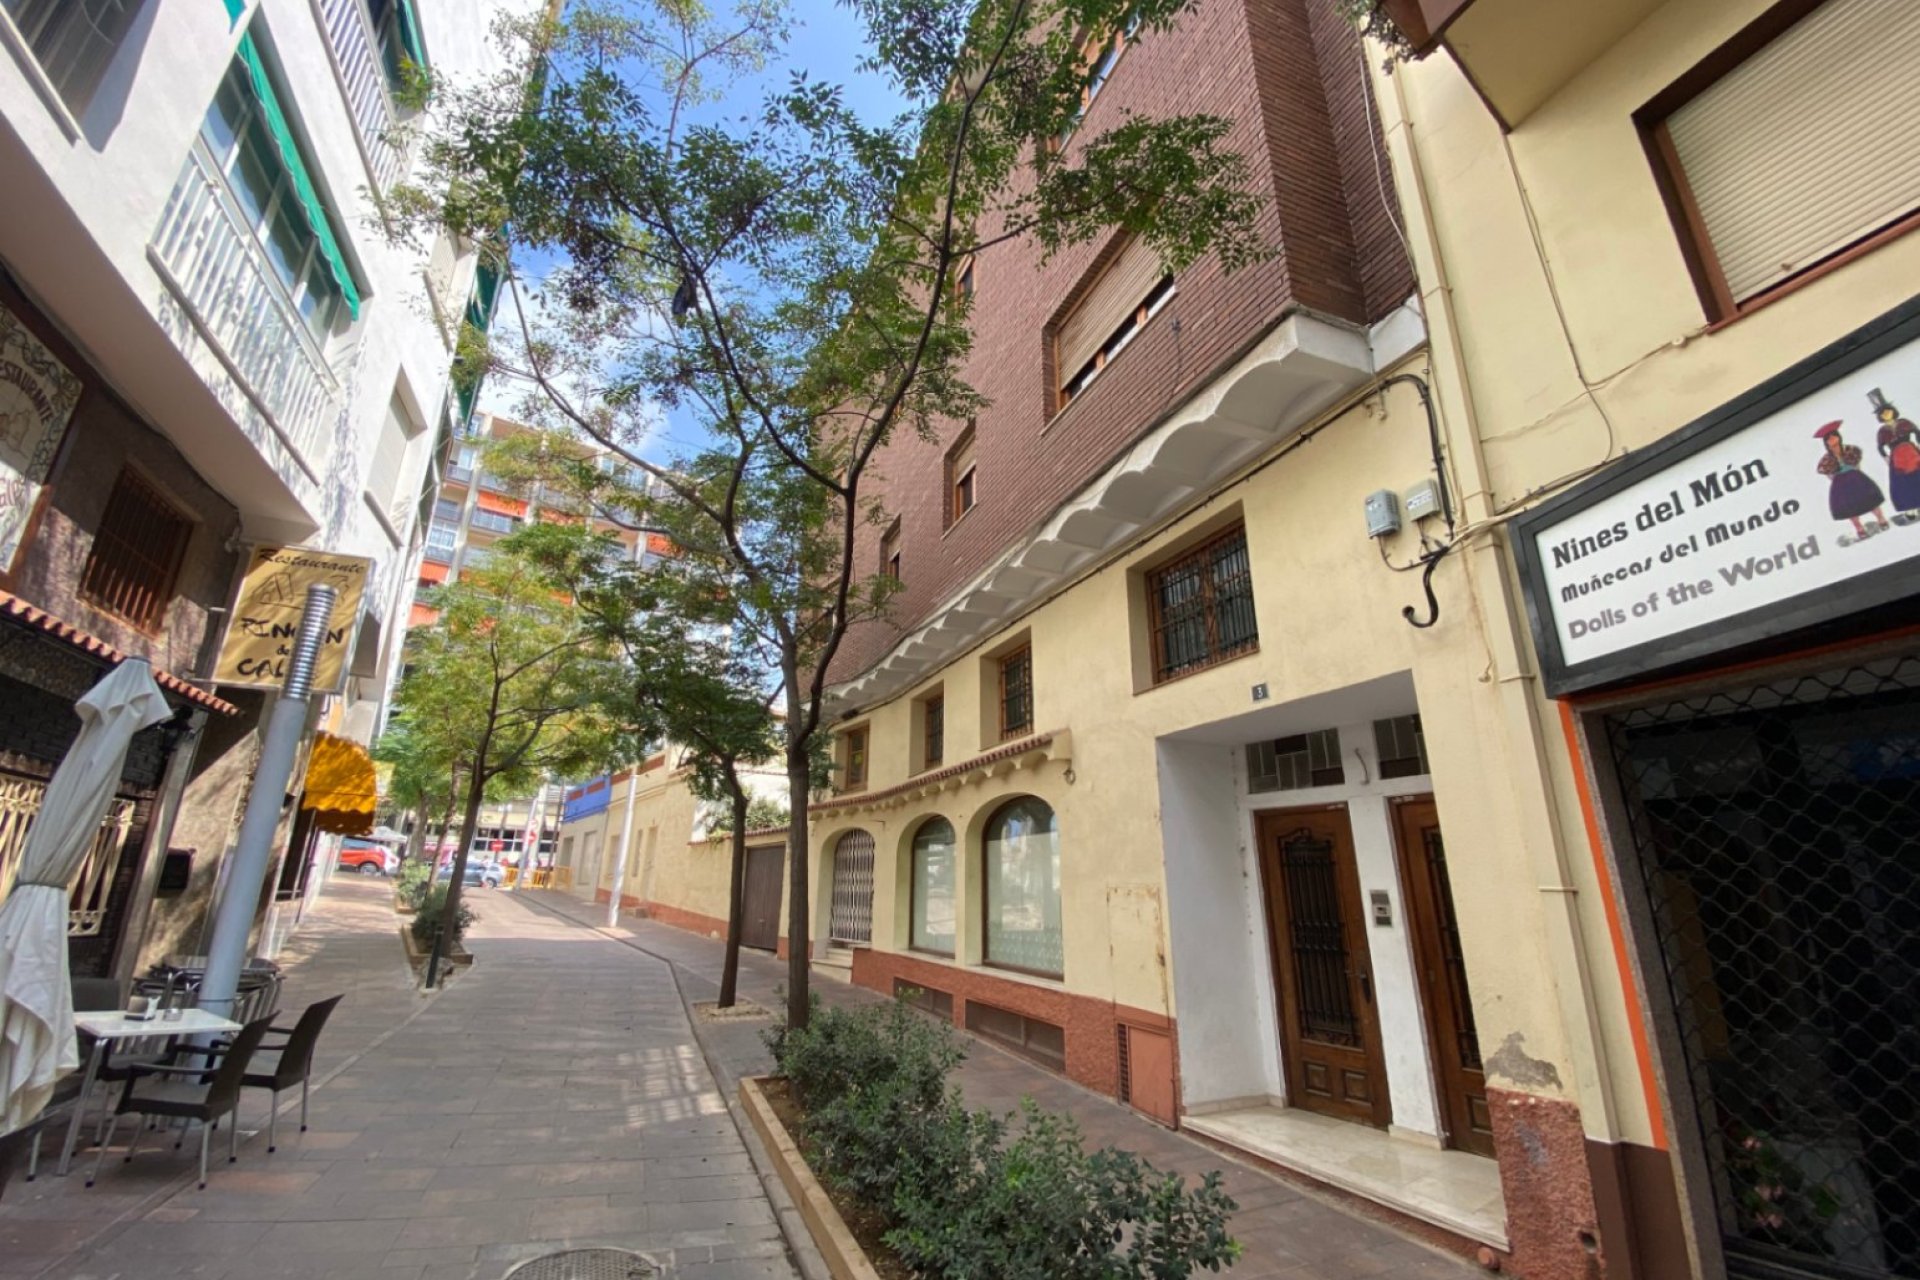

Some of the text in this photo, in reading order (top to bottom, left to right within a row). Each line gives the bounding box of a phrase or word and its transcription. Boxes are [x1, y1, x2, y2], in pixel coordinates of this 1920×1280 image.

[256, 548, 366, 574] Restaurante
[1551, 457, 1769, 569] Nines del Món
[1561, 497, 1801, 604] Muñecas del Mundo
[1568, 535, 1821, 640] Dolls of the World
